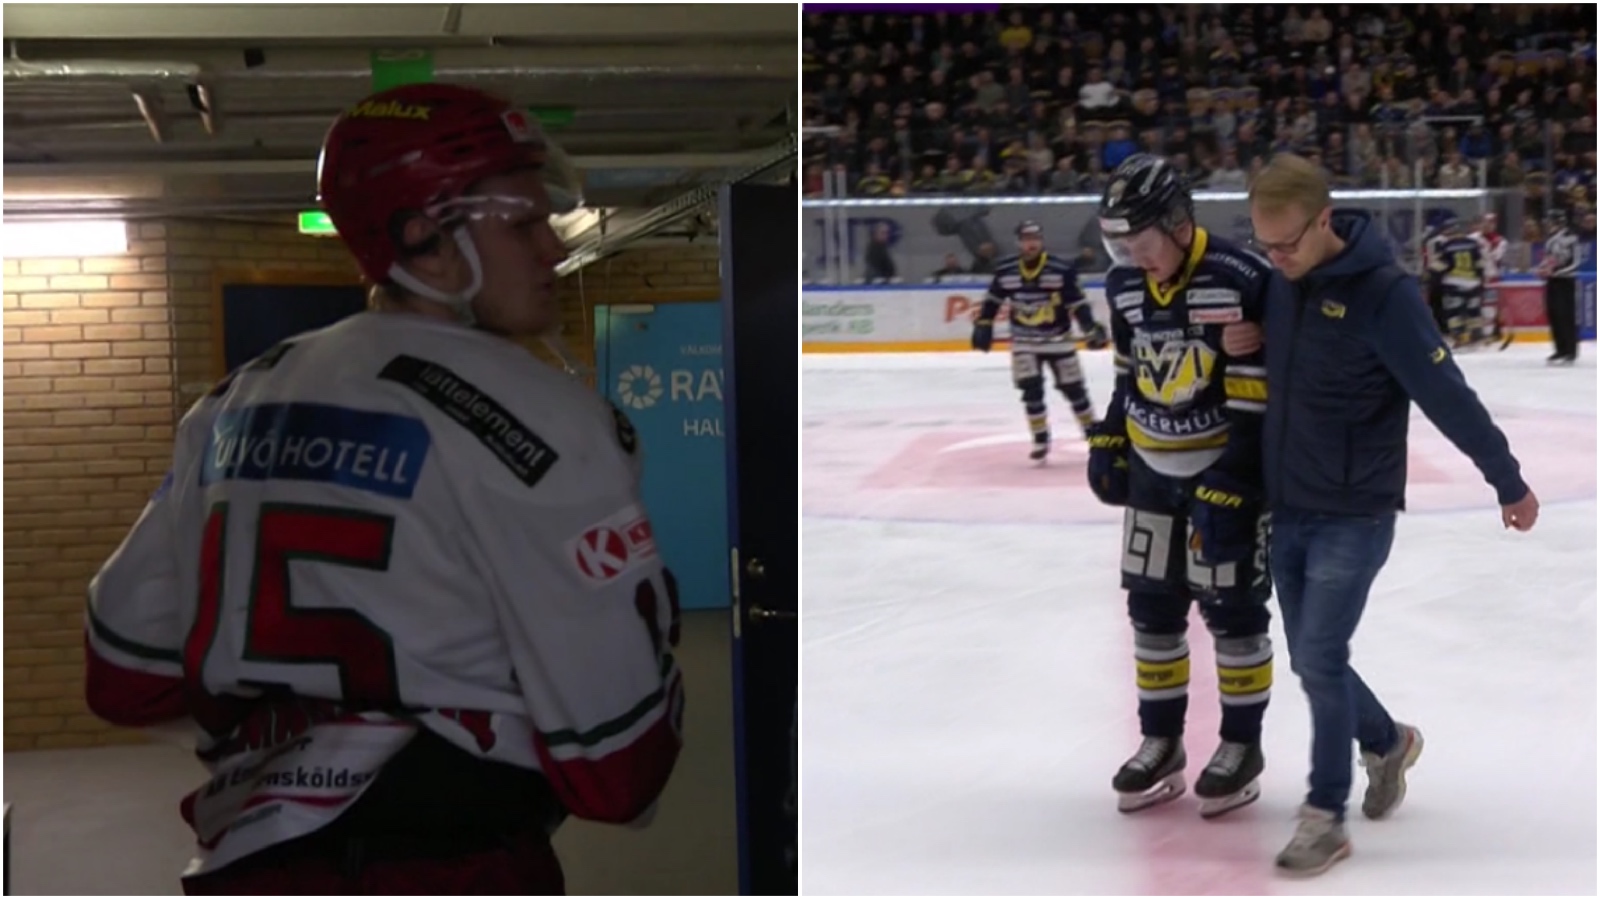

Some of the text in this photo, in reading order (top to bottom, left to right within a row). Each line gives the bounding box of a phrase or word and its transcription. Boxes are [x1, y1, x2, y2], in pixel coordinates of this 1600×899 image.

[671, 367, 725, 402] RA
[280, 435, 409, 485] HOTELL
[184, 500, 402, 713] 15
